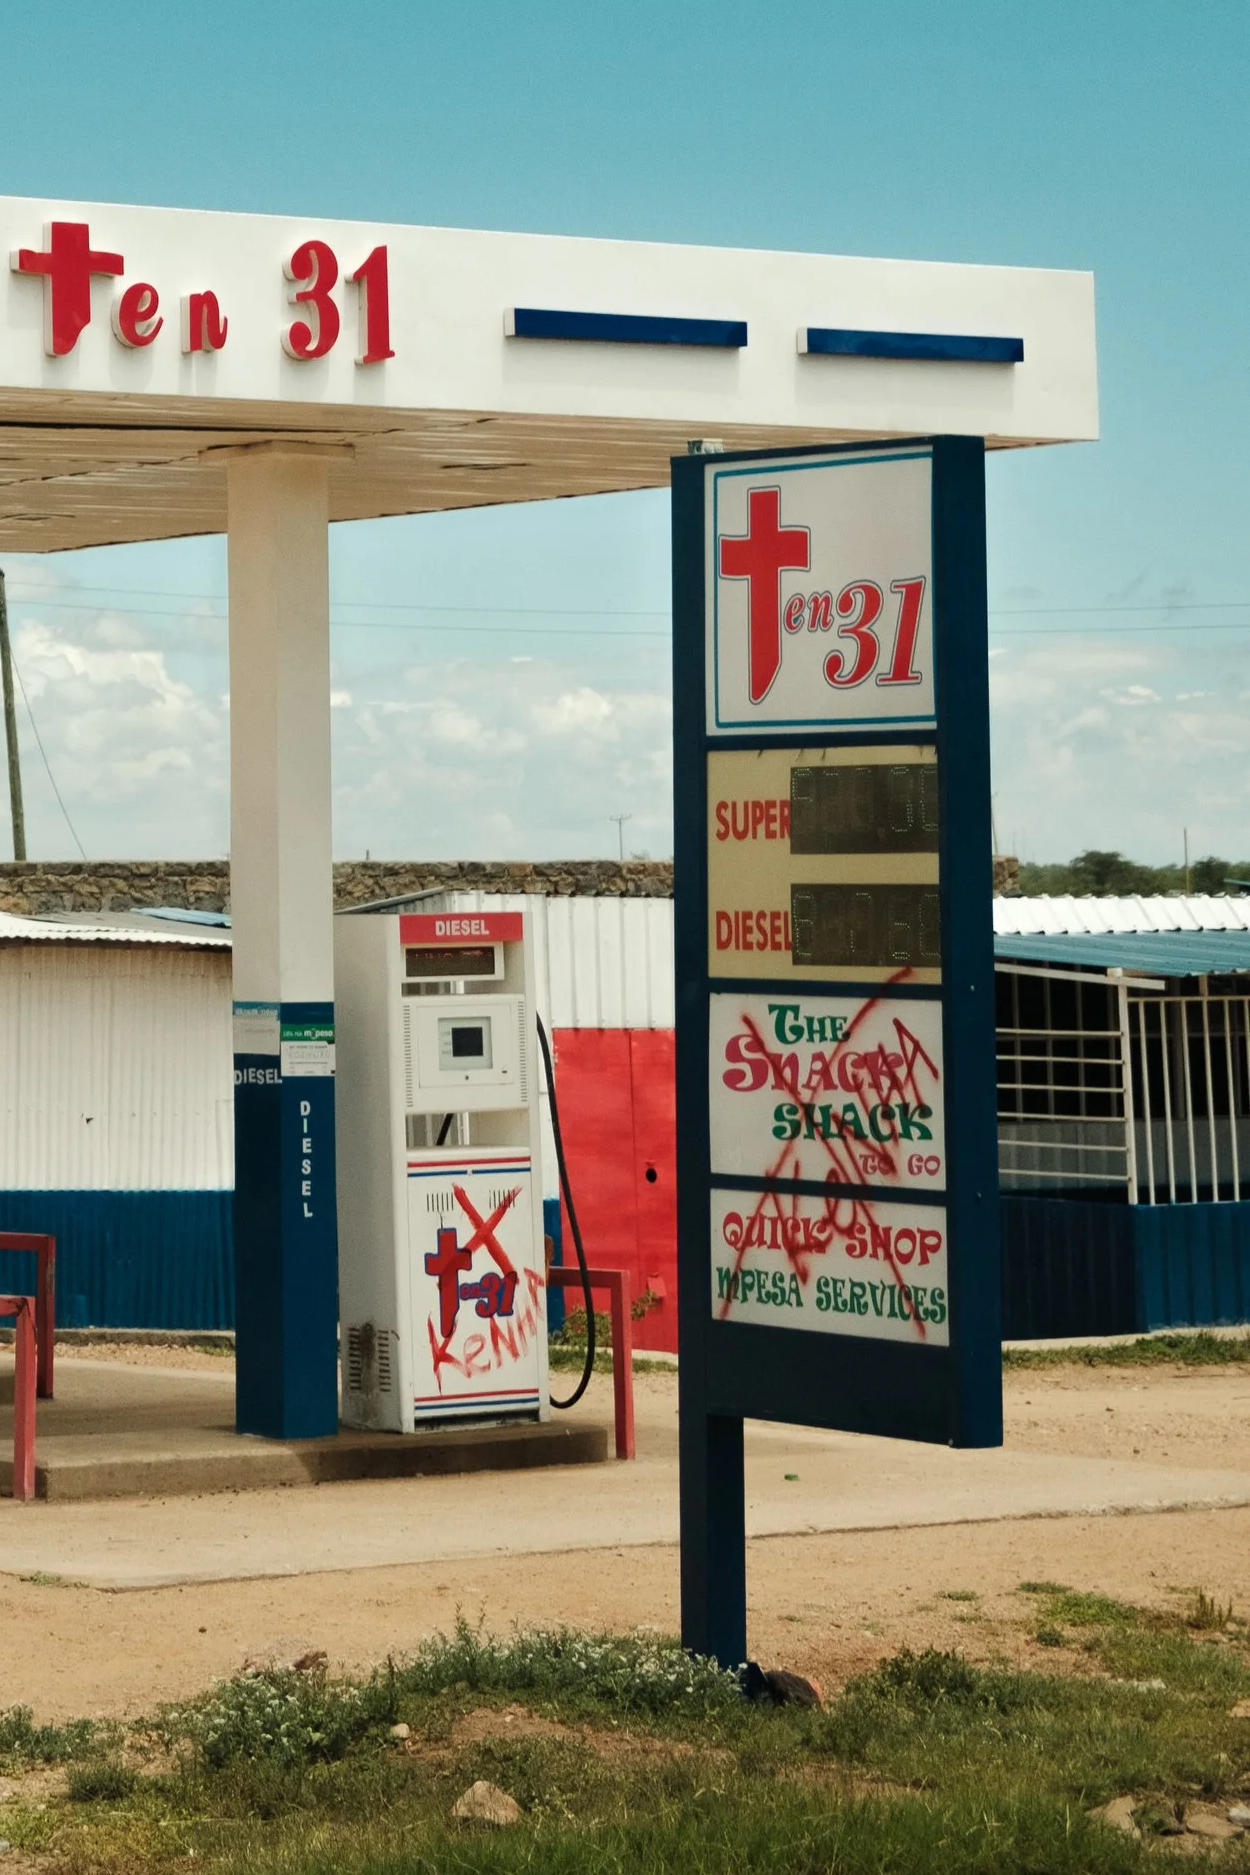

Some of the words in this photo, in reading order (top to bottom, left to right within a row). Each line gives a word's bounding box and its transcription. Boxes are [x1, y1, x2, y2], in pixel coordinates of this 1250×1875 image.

[281, 239, 396, 364] 31
[715, 799, 791, 841] SUPER
[435, 919, 490, 936] DIESEL
[715, 910, 792, 951] DIESEL
[234, 1068, 283, 1085] DIESEL
[772, 1101, 933, 1142] SHACK
[300, 1101, 313, 1218] DIESEL
[907, 1153, 941, 1176] GO
